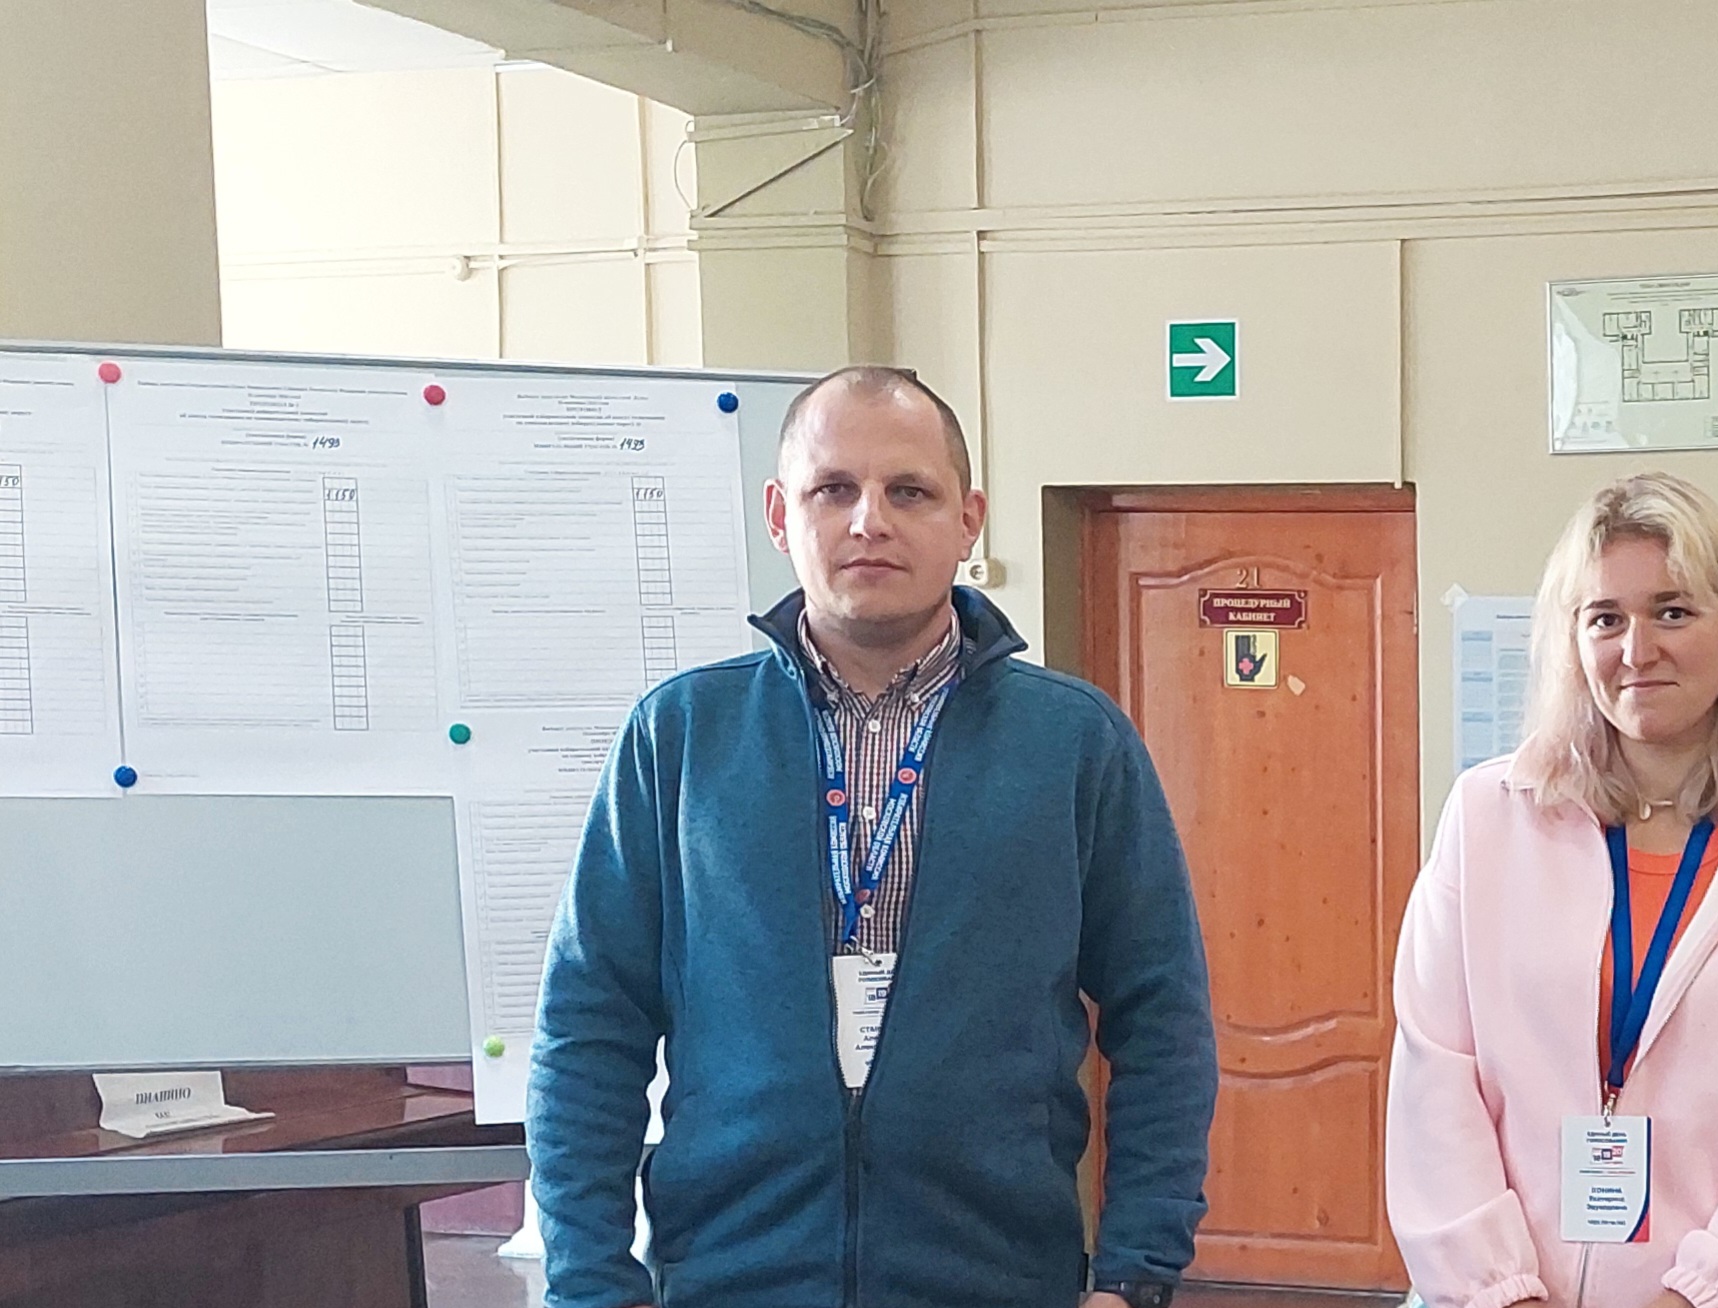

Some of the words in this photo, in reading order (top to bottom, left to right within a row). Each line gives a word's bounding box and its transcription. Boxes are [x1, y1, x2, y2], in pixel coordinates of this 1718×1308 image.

[1235, 567, 1261, 589] 21
[1213, 598, 1291, 609] ПРОЦЕДУРНЫЙ
[1228, 612, 1276, 622] КАБИНЕТ
